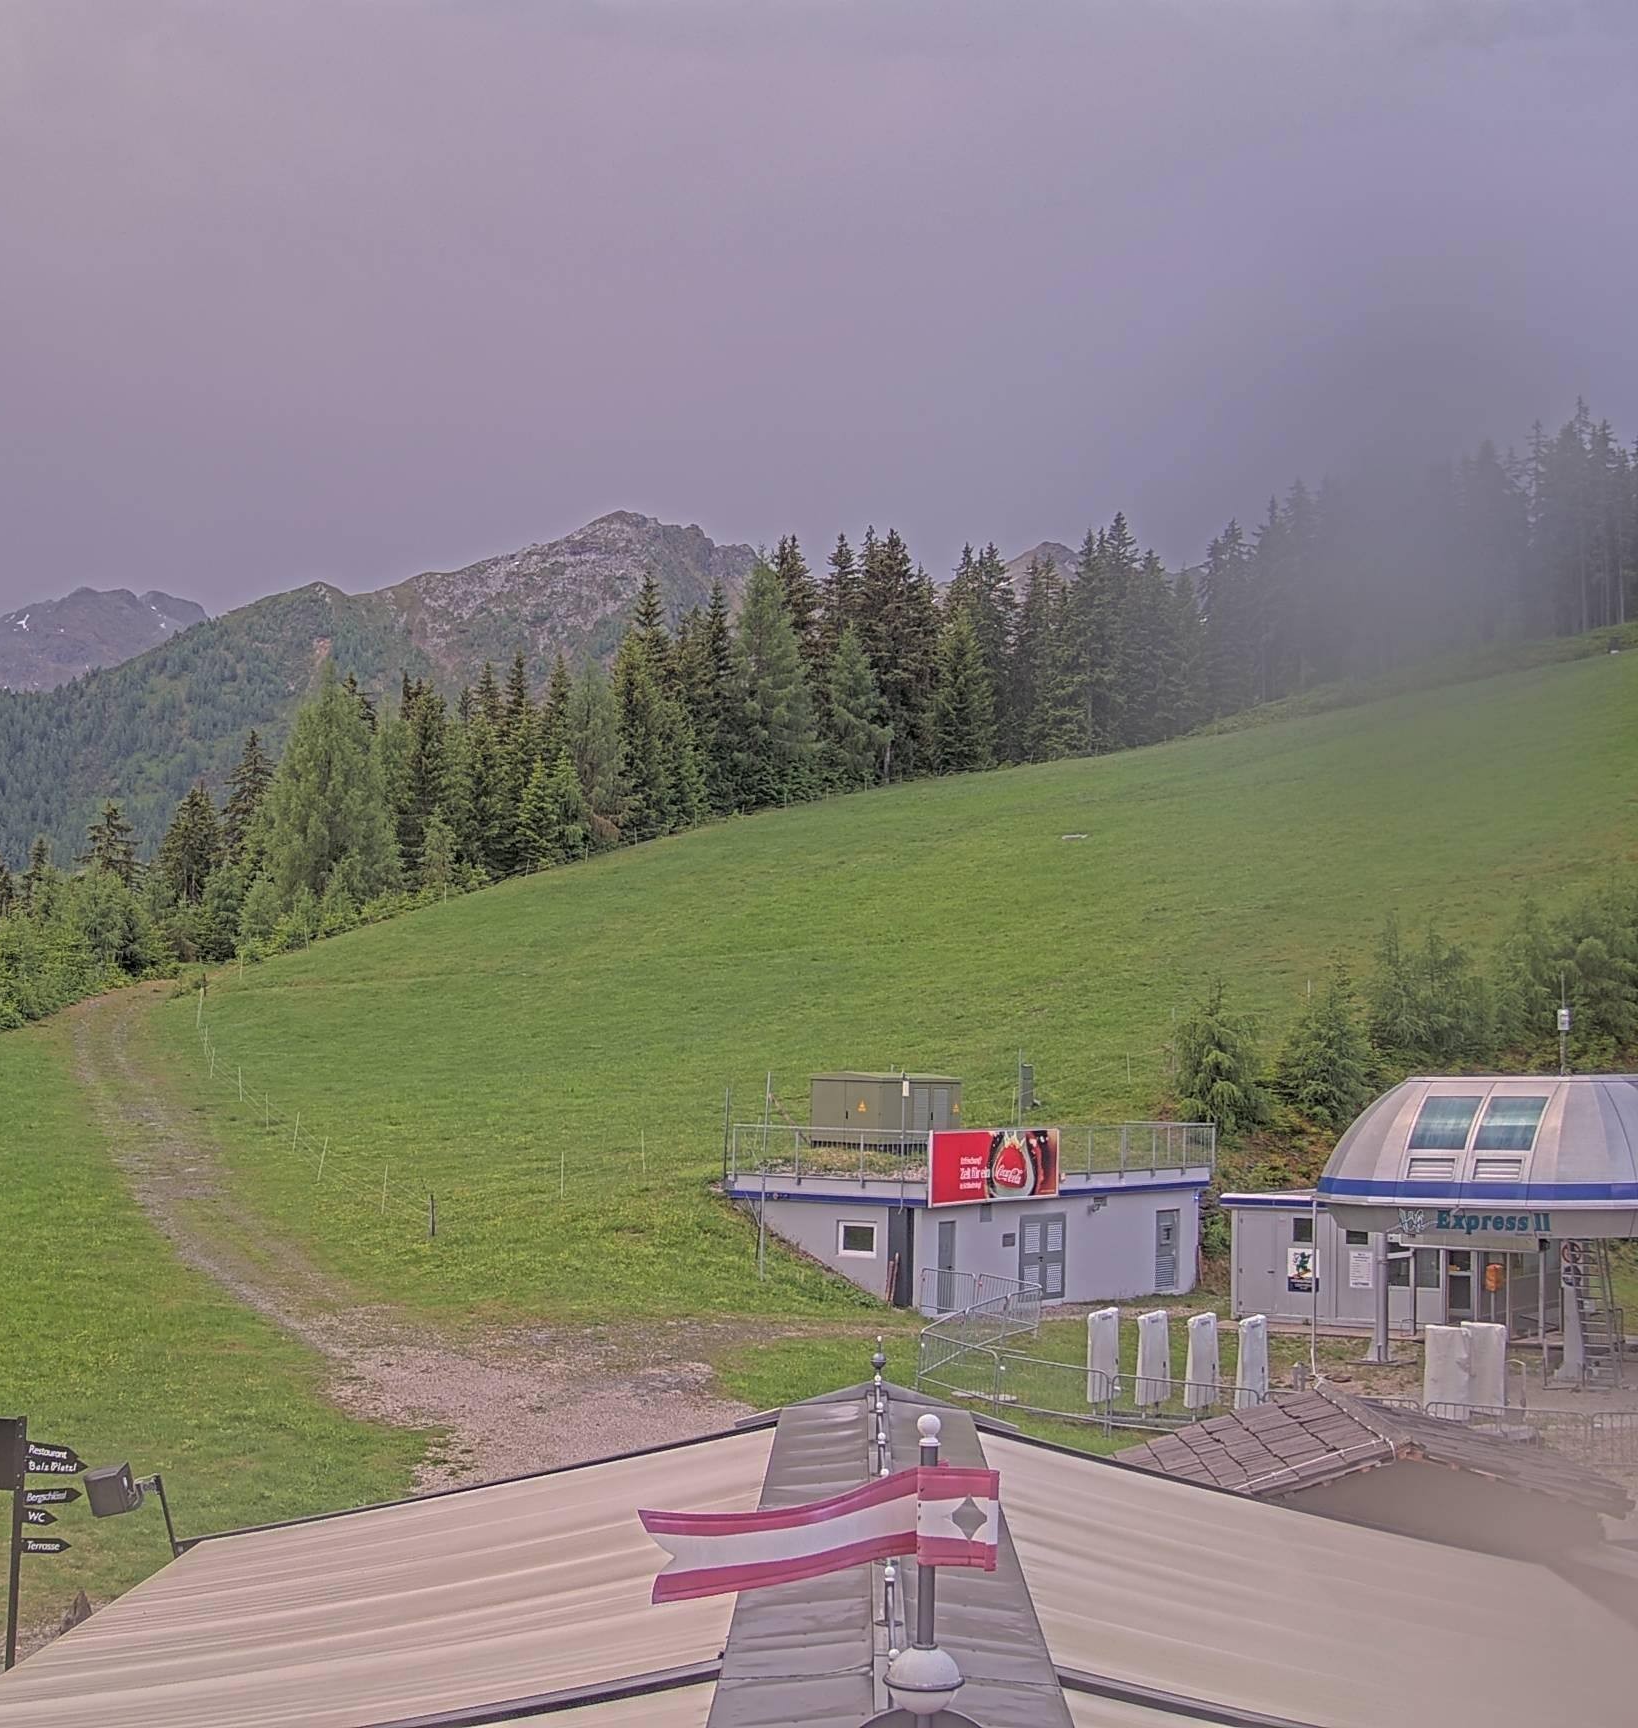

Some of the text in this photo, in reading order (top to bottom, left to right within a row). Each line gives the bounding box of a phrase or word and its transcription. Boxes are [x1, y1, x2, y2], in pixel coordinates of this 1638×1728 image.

[971, 1166, 981, 1179] für
[1436, 1209, 1530, 1235] Express
[1534, 1212, 1551, 1232] II
[28, 1444, 67, 1460] Restaurant
[28, 1511, 46, 1522] WC
[26, 1540, 60, 1551] Terrasse
